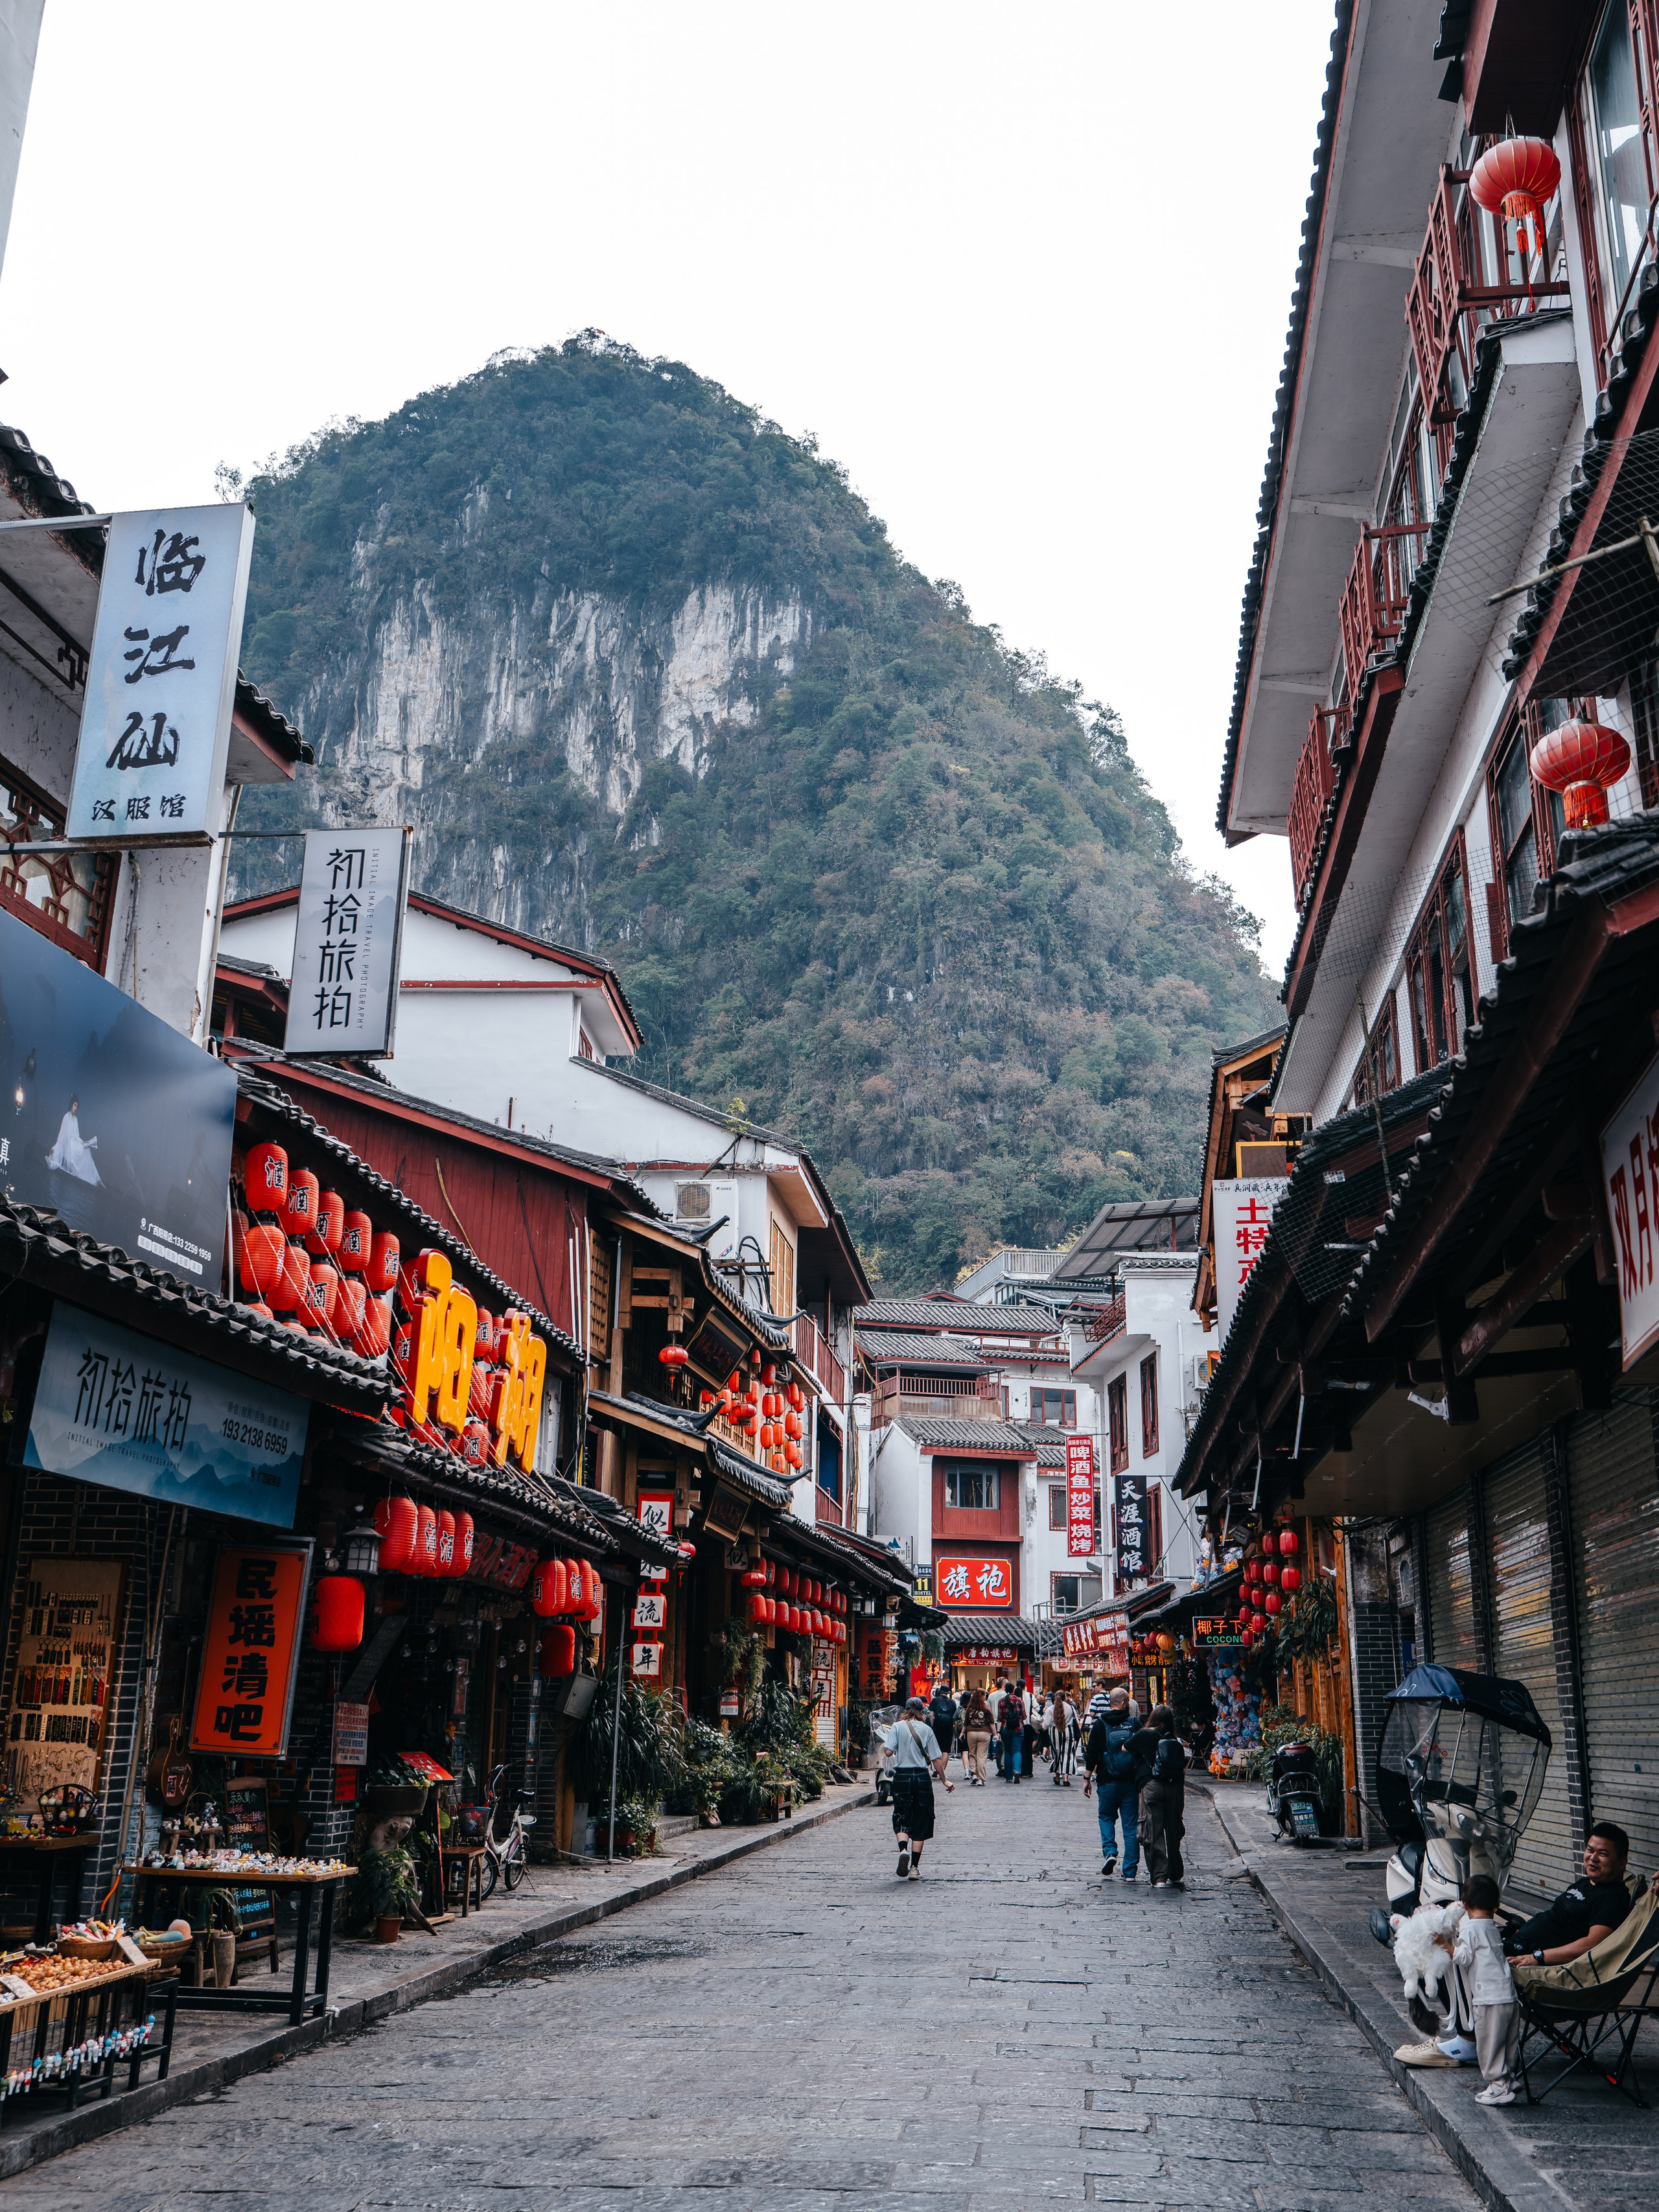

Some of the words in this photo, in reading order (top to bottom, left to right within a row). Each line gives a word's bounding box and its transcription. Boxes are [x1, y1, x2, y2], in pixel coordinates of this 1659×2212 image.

[107, 529, 205, 770] 临江仙
[92, 795, 187, 822] 汉服馆
[369, 848, 380, 885] INITIAL
[366, 891, 376, 918] IMAGE
[312, 848, 365, 1030] 初拾旅拍
[363, 924, 373, 959] TRAVEL
[356, 964, 369, 1029] PHOTOGRAPHY
[265, 1156, 285, 1192] 酒
[288, 1183, 310, 1215] 酒
[184, 1240, 198, 1255] 2259
[198, 1248, 211, 1261] 1959
[75, 1347, 192, 1452] 初拾旅拍
[67, 1432, 93, 1447] INITIAL
[96, 1440, 115, 1453] IMAGE
[118, 1447, 139, 1460] TRAVEL
[142, 1454, 181, 1470] PHOTOGRAPHY
[223, 1418, 240, 1440] 193
[240, 1424, 264, 1448] 2138
[264, 1432, 288, 1455] 6959
[1070, 1446, 1091, 1489] 啤酒鱼
[1070, 1491, 1091, 1520] 炒菜
[1071, 1523, 1092, 1553] 烧烤
[1120, 1480, 1144, 1573] 天涯酒馆
[916, 1578, 928, 1590] 11
[942, 1563, 1007, 1600] 旗袍
[968, 1647, 1012, 1659] 唐韵旗袍
[1207, 1635, 1242, 1644] COCONU
[1144, 1654, 1157, 1666] 烧烤
[1422, 1887, 1431, 1898] YAMAHA
